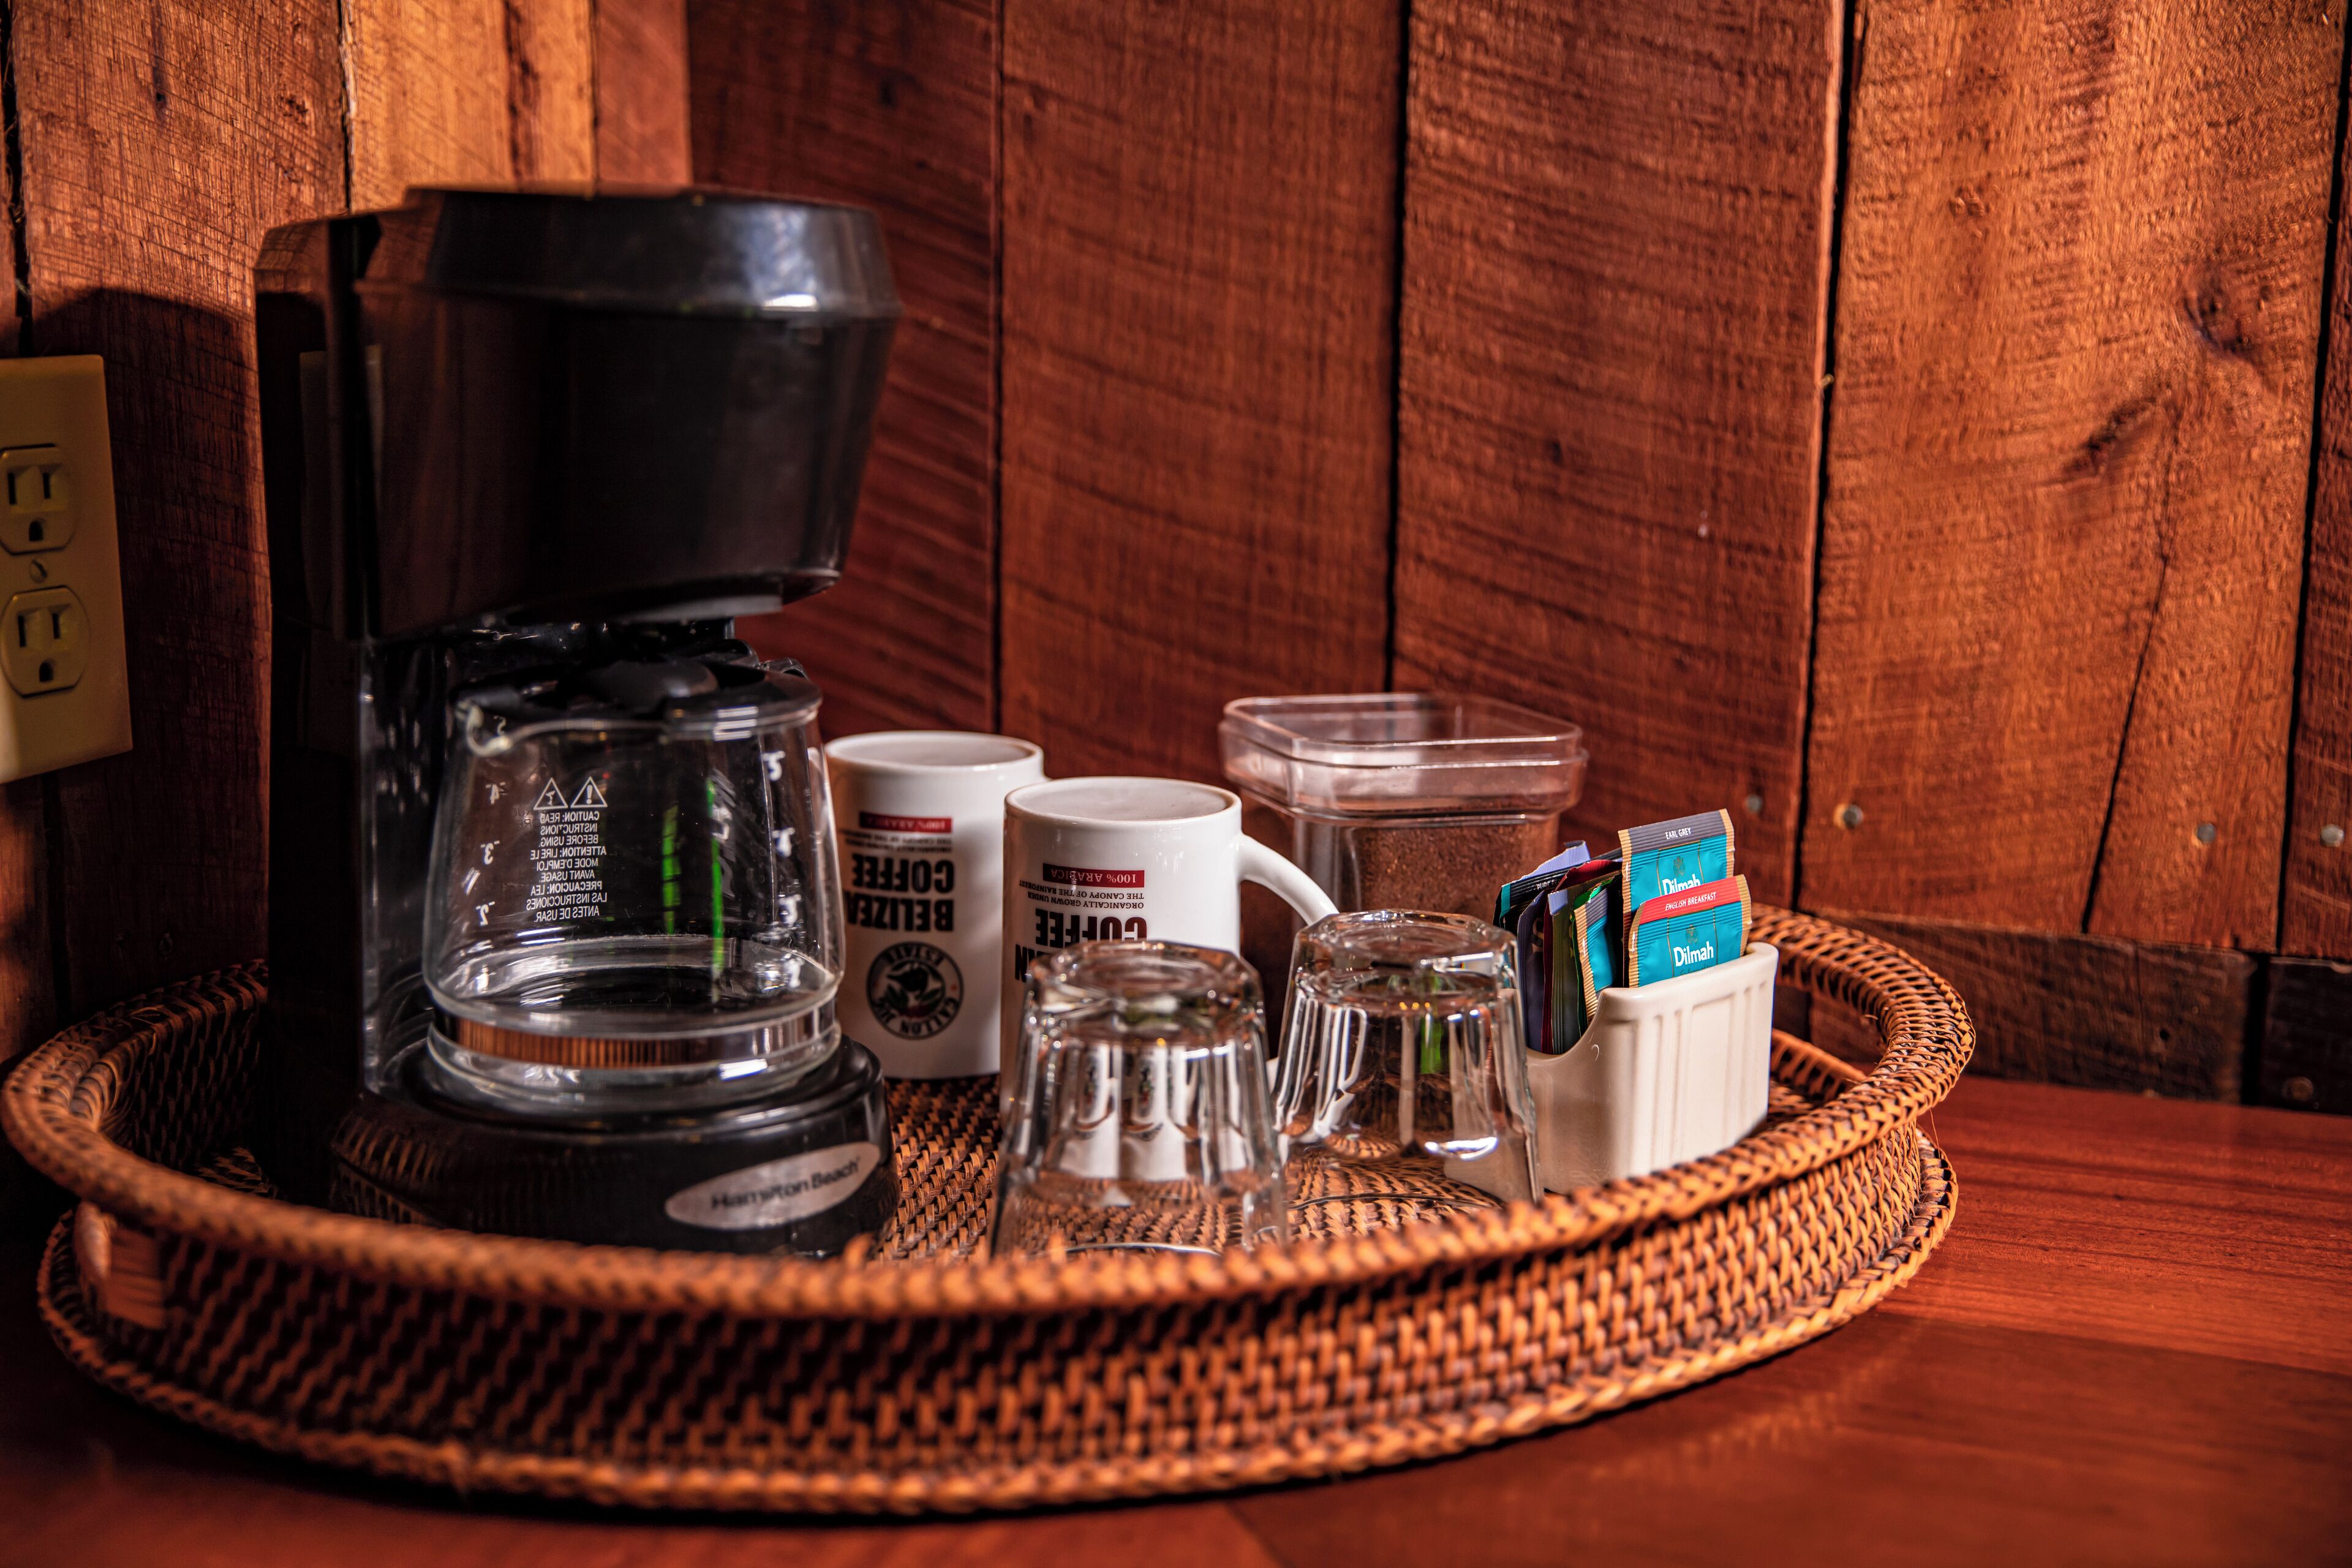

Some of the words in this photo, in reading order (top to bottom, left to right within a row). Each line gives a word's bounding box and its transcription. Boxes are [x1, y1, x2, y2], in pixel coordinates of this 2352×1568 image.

[1665, 831, 1678, 840] EARL
[1678, 827, 1691, 837] GREY
[852, 854, 954, 893] COFFEE
[1051, 869, 1102, 882] ARABICA
[1106, 874, 1137, 883] 100%
[1019, 880, 1057, 894] RAINFOREST
[1662, 873, 1701, 895] Dilmah
[1027, 891, 1049, 903] UNDER
[1058, 888, 1075, 897] THE
[1050, 897, 1081, 907] GROWN
[1083, 900, 1144, 909] ORGANICALLY
[1665, 899, 1687, 911] ENGLISH
[1687, 892, 1717, 906] BREAKFAST
[844, 891, 954, 932] BELIZEA
[1035, 908, 1147, 949] COFFEE
[1673, 941, 1714, 967] Dilmah
